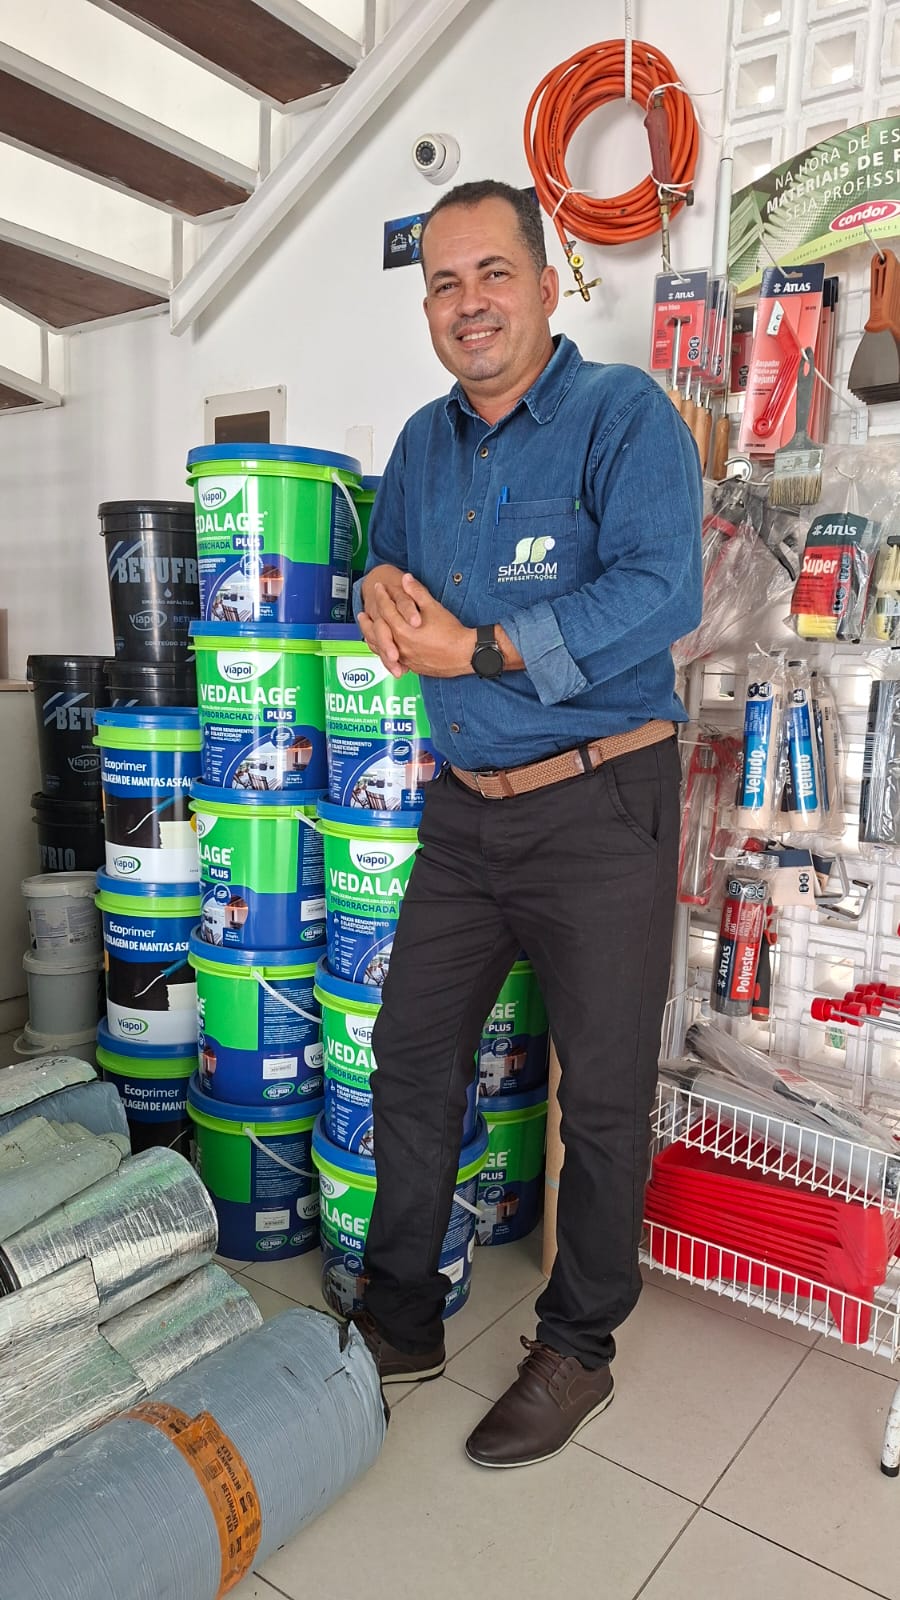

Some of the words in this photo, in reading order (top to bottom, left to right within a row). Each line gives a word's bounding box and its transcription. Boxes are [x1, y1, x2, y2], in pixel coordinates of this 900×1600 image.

[775, 171, 793, 191] NA
[799, 147, 841, 177] HORA
[848, 134, 870, 155] DE
[767, 162, 850, 214] MATERIAIS
[858, 151, 884, 171] DE
[786, 198, 818, 222] SEJA
[823, 169, 900, 206] PROFISSI
[838, 204, 888, 228] condor
[674, 290, 695, 299] ATLAS
[783, 282, 811, 293] ATLAS
[202, 490, 222, 503] Viapol
[235, 537, 260, 547] PLUS
[498, 562, 558, 577] SHALOM
[801, 555, 838, 577] Super
[129, 614, 160, 628] Viapol
[223, 665, 252, 677] Viapol
[342, 671, 369, 684] Viapol
[200, 683, 297, 706] VEDALAGE
[266, 710, 293, 720] PLUS
[384, 722, 412, 732] PLUS
[68, 757, 99, 769] Viapol
[104, 757, 147, 772] Ecoprimer
[745, 749, 764, 795] Veludo
[798, 754, 815, 798] Veludo
[122, 775, 132, 786] DE
[132, 776, 165, 787] MANTAS
[114, 857, 135, 870] Viapol
[356, 853, 387, 868] Viapol
[210, 867, 229, 879] PLUS
[330, 867, 409, 897] VEDALA
[109, 920, 156, 937] Ecoprimer
[129, 941, 138, 950] DE
[140, 942, 174, 952] MANTAS
[719, 945, 732, 978] ATLAS
[736, 946, 756, 993] Polyester
[118, 1017, 142, 1031] Viapol
[488, 1023, 512, 1032] PLUS
[124, 1084, 179, 1099] Ecoprimer
[150, 1102, 161, 1111] DE
[161, 1101, 187, 1111] MANT
[480, 1171, 504, 1181] PLUS
[340, 1233, 362, 1250] PLUS
